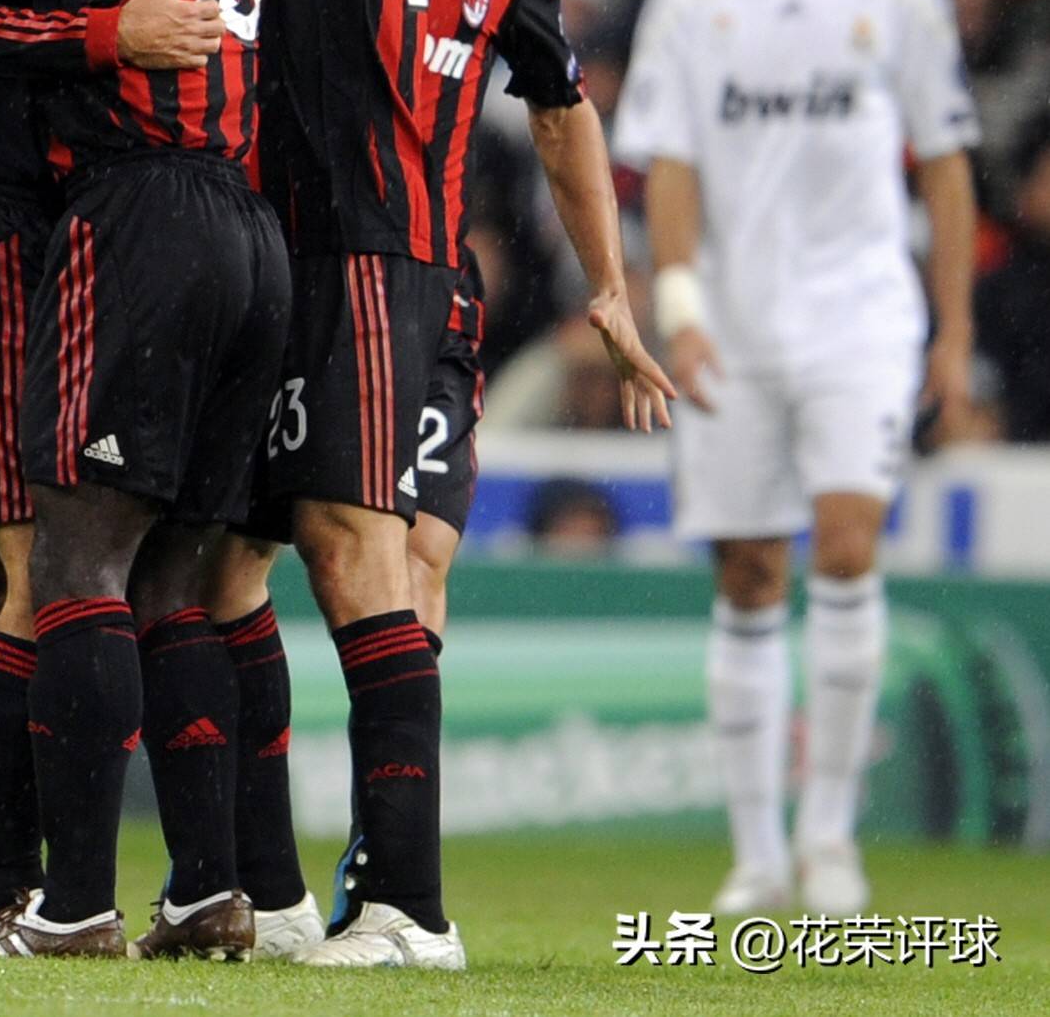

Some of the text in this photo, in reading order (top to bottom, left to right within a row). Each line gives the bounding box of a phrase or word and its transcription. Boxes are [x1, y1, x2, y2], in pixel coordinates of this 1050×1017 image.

[720, 71, 858, 124] bwin
[267, 377, 308, 459] 23
[416, 406, 450, 474] 2
[83, 447, 125, 466] adidas
